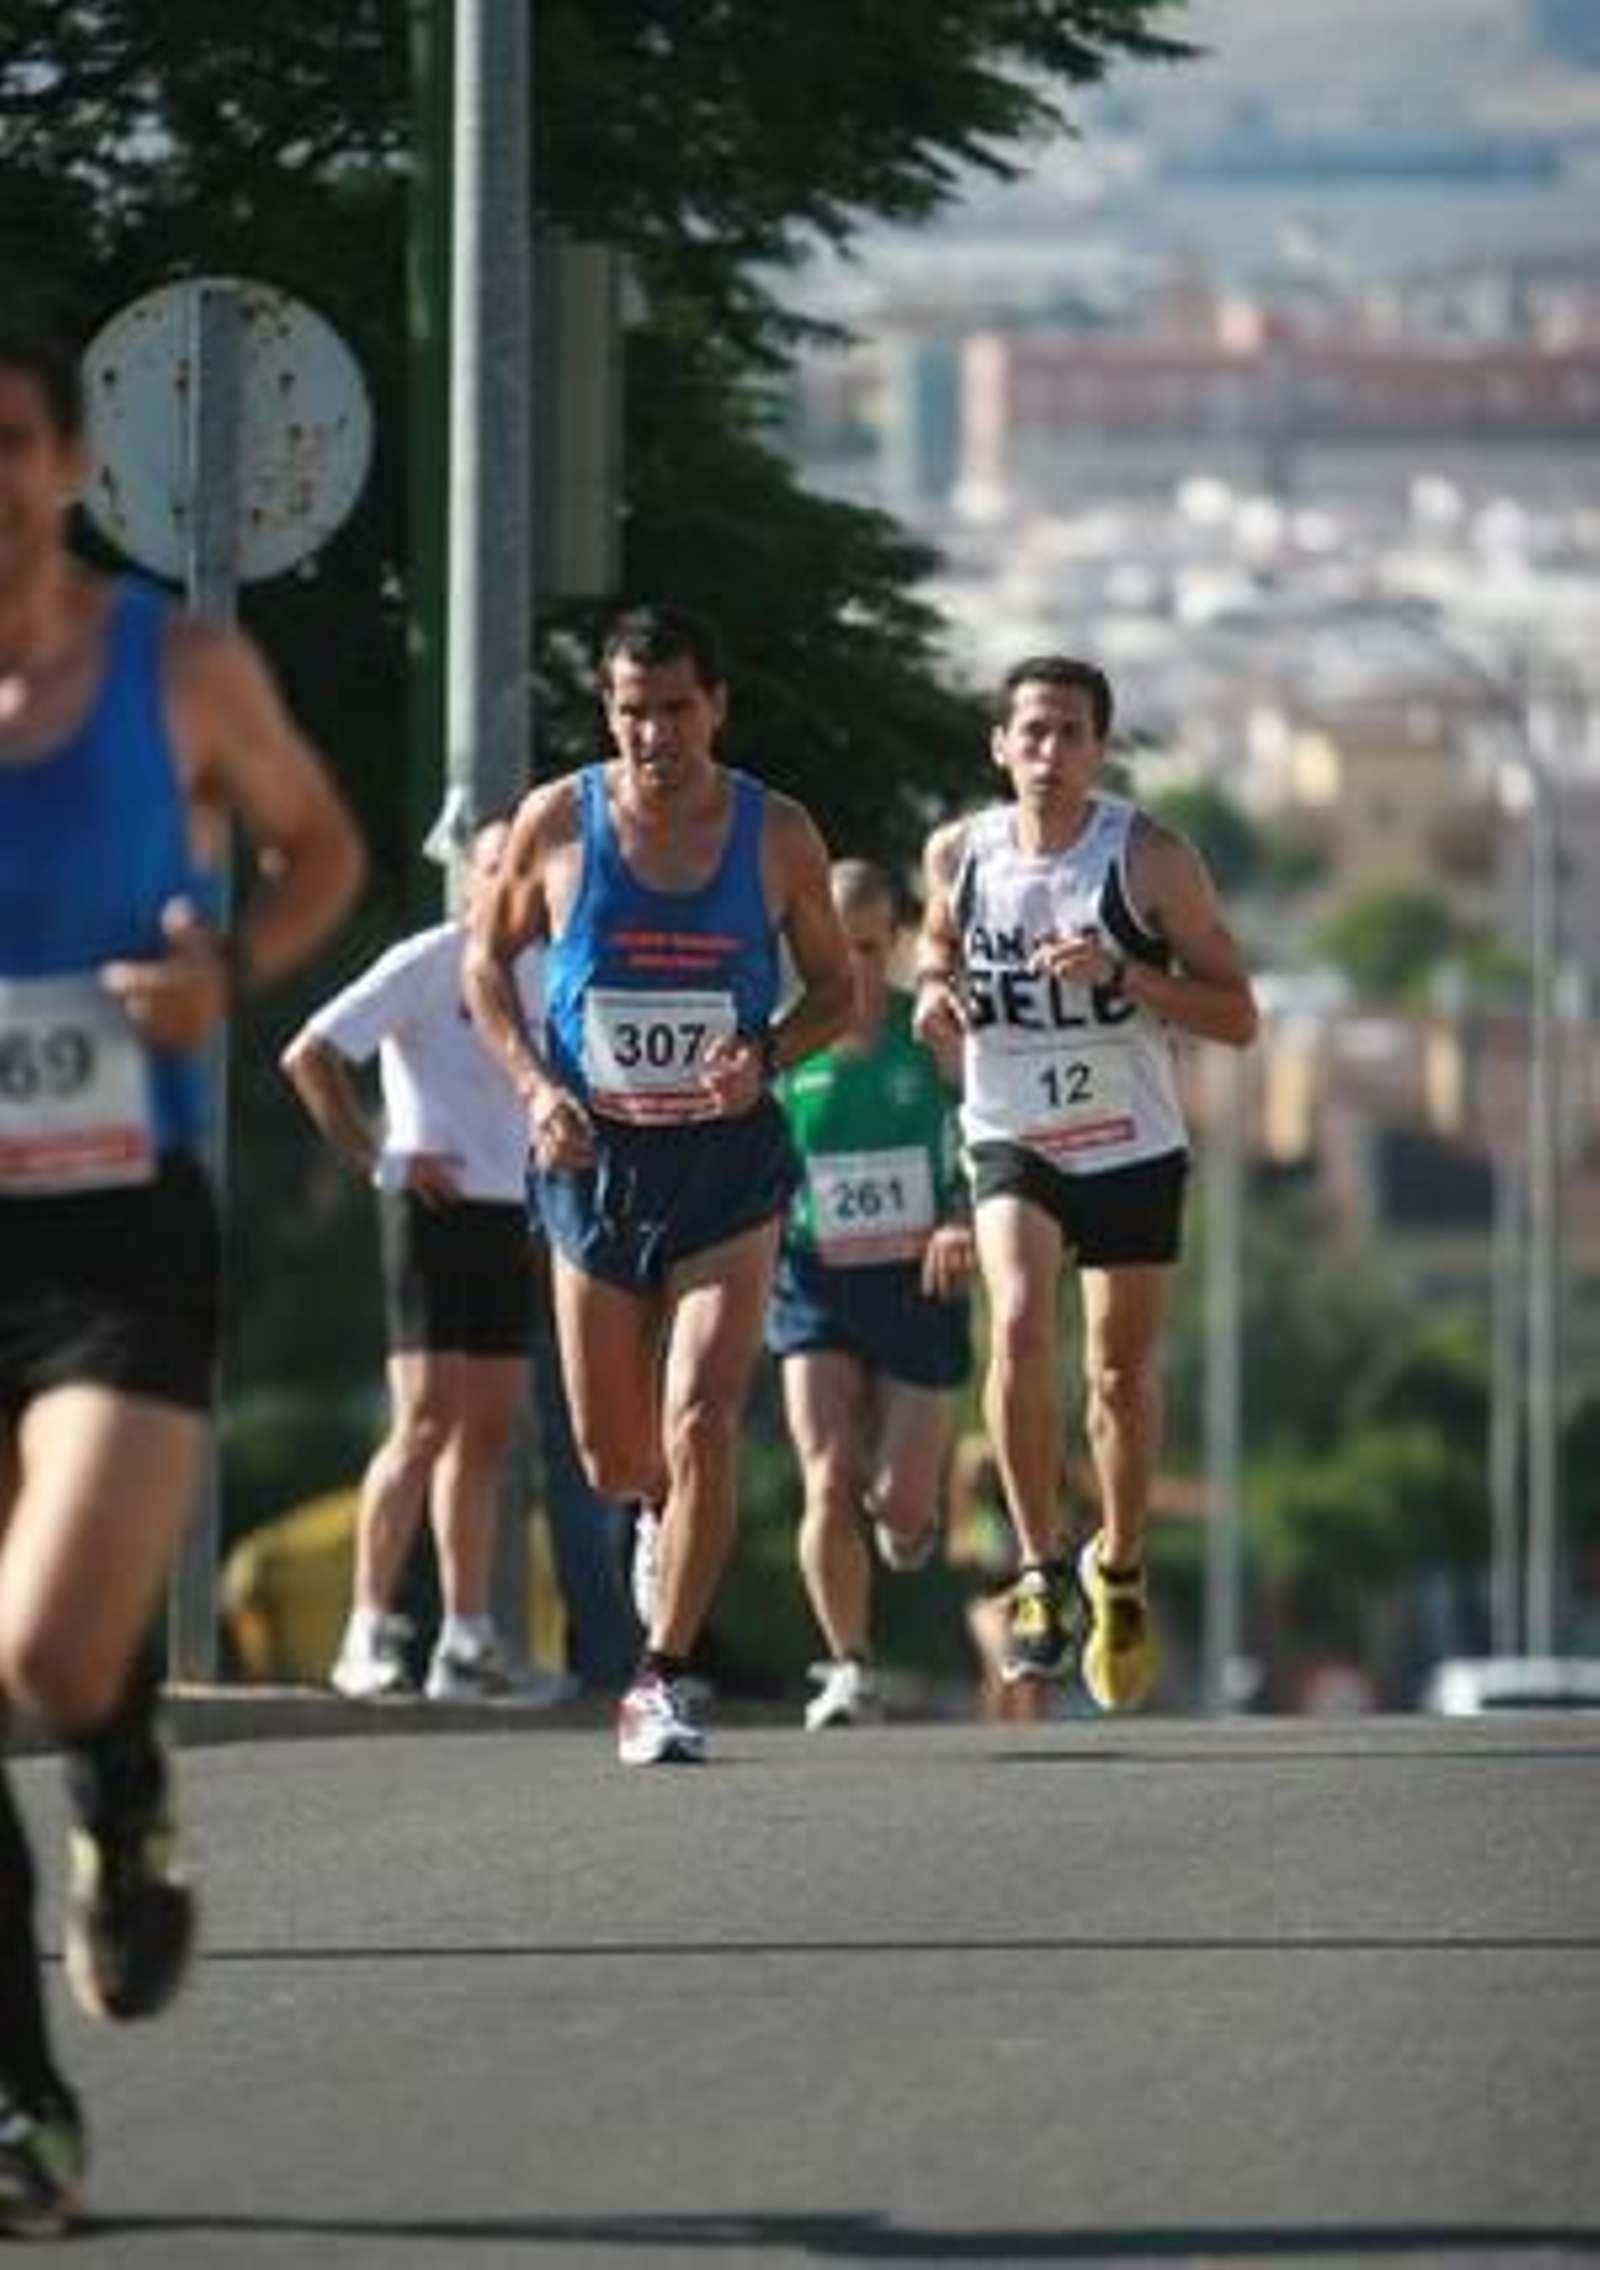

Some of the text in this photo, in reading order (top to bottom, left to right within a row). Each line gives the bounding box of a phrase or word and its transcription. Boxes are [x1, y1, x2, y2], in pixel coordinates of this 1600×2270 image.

[613, 1022, 706, 1068] 307
[1038, 1060, 1094, 1108] 12
[833, 1176, 905, 1221] 261
